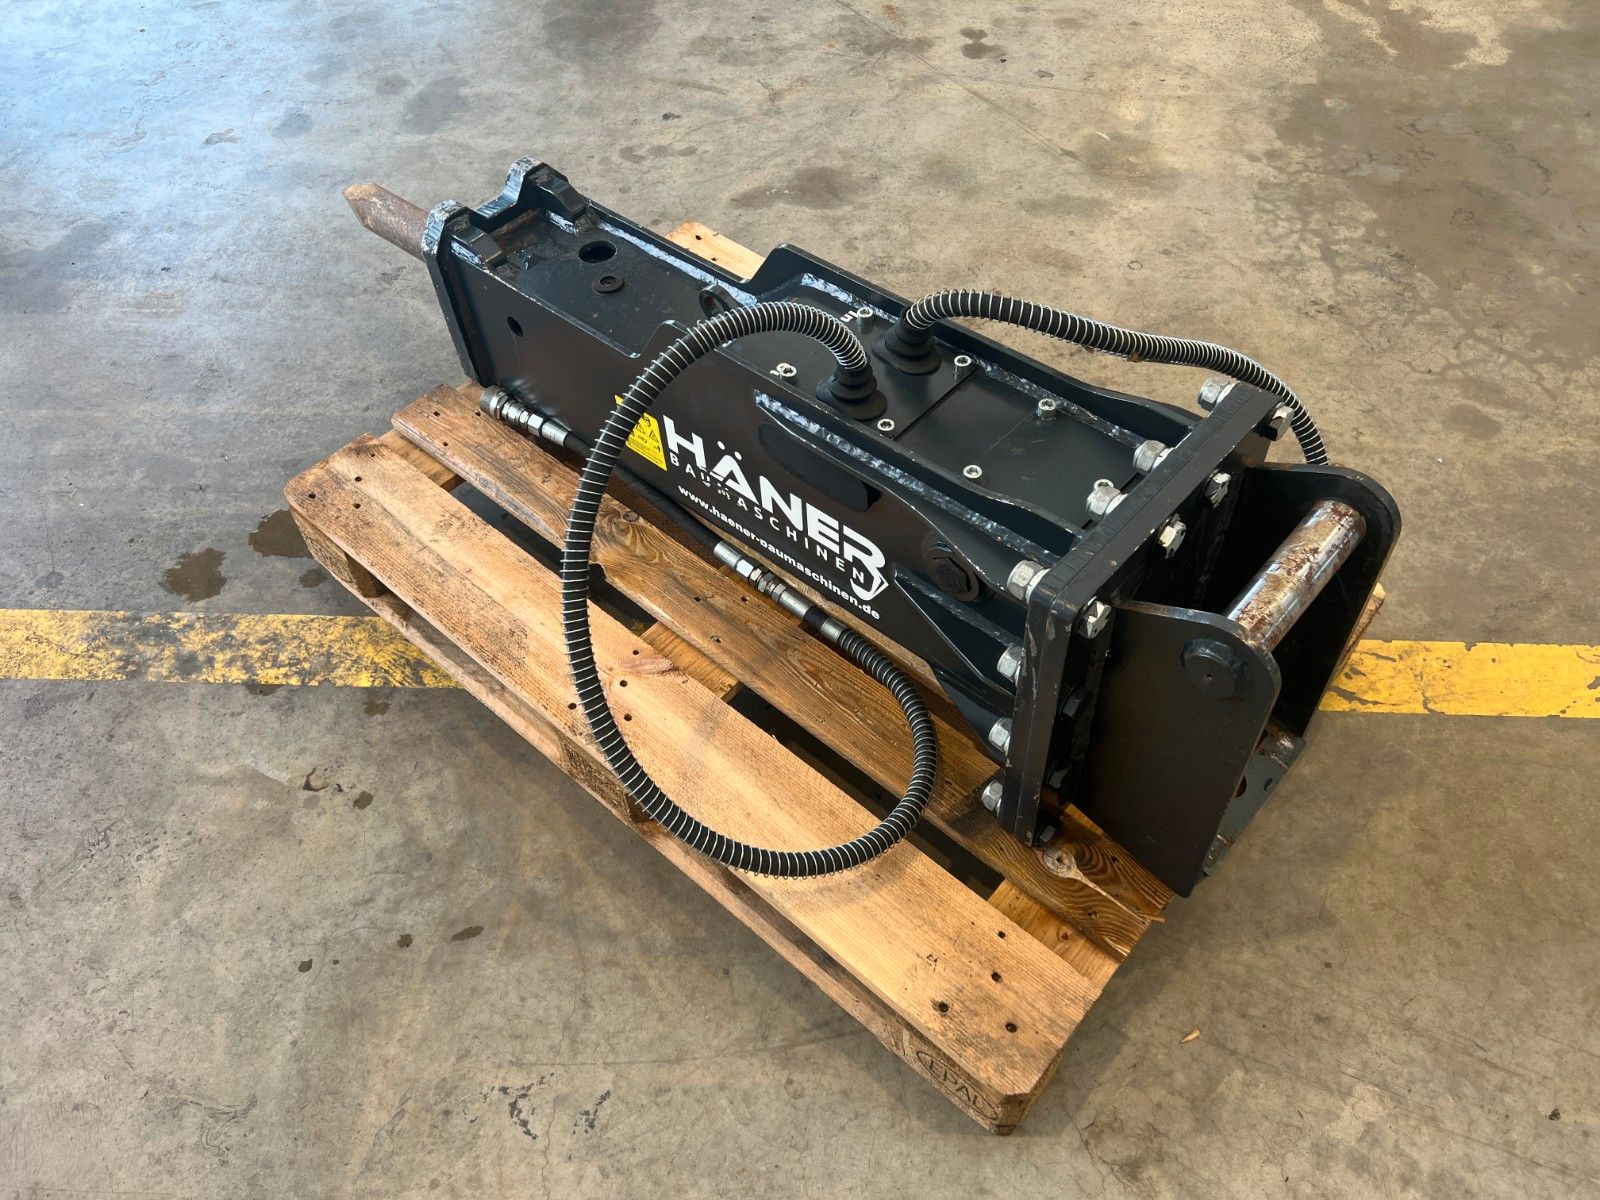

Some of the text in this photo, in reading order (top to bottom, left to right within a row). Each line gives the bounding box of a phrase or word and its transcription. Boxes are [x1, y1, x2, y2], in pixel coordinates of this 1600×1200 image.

[663, 415, 889, 601] HÄNER
[678, 485, 880, 620] www.haener-baumaschinen.de
[929, 1058, 984, 1113] EPAL
